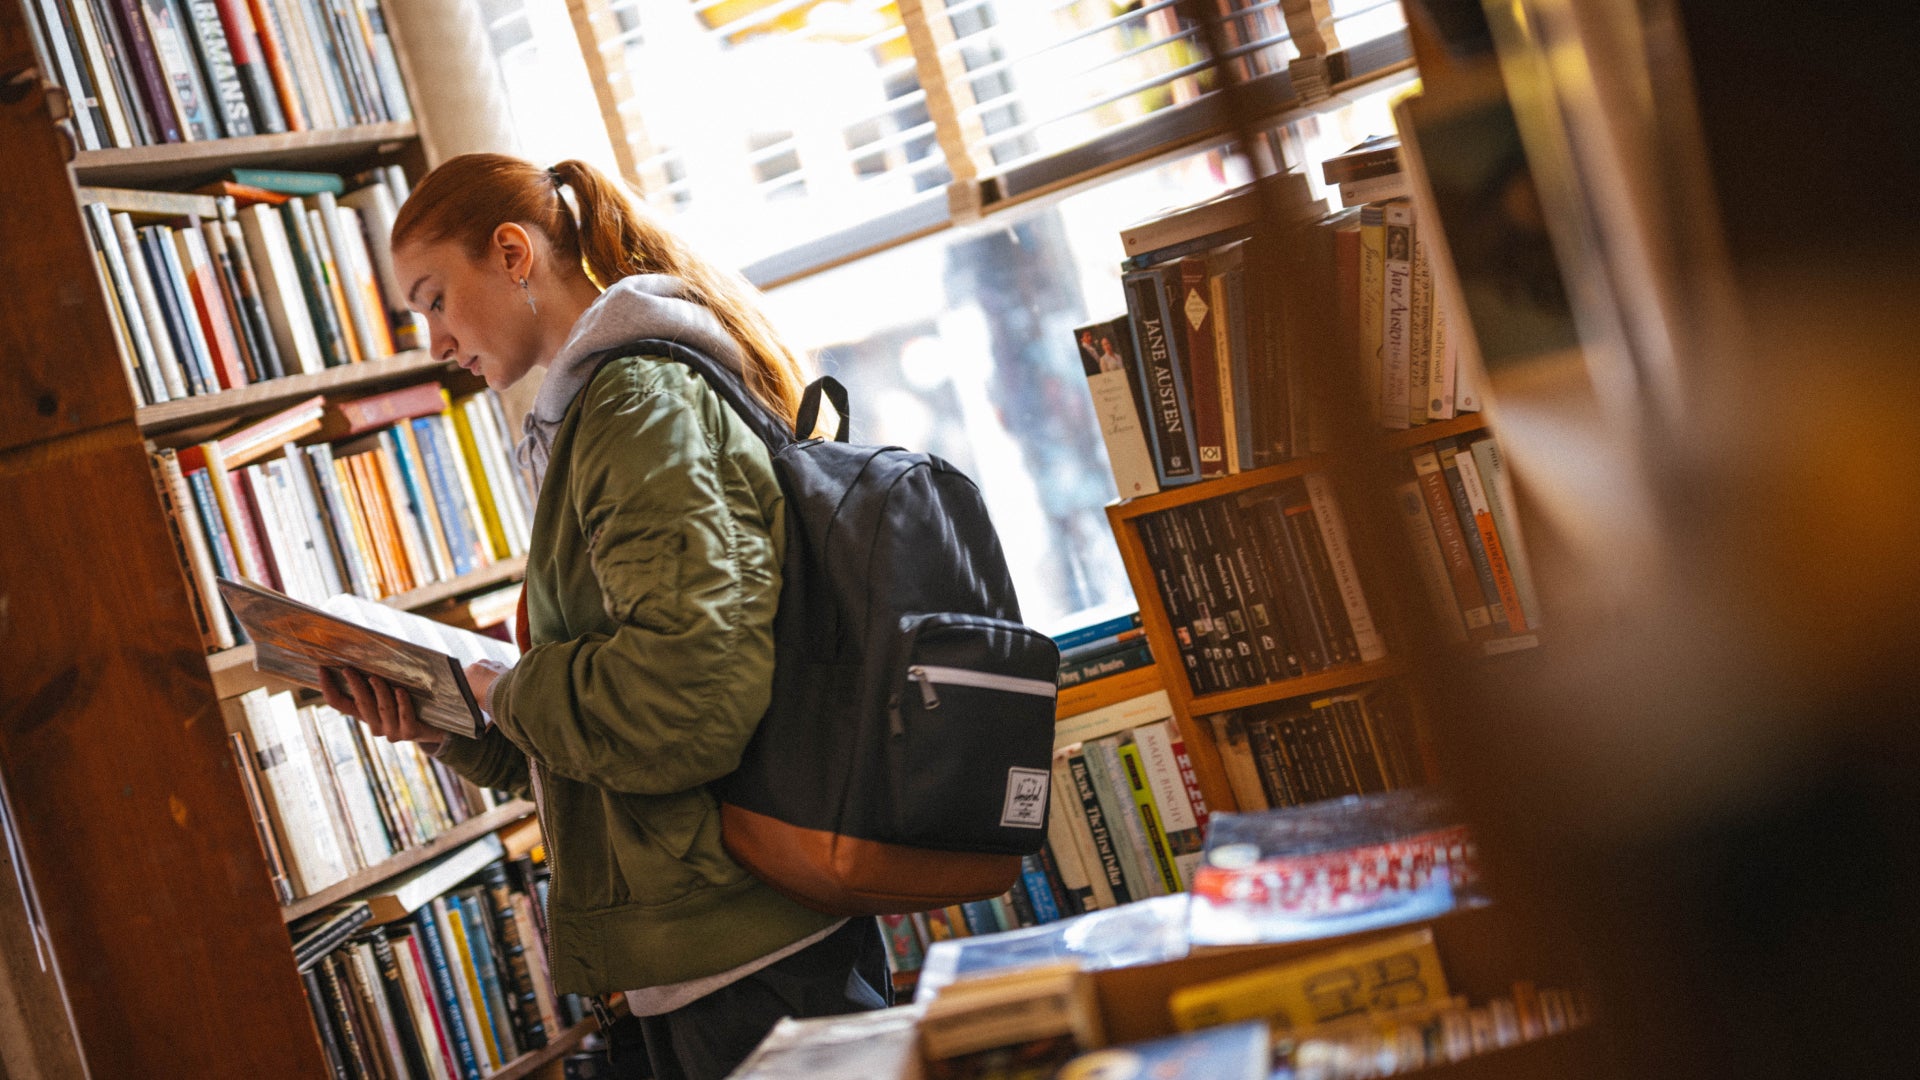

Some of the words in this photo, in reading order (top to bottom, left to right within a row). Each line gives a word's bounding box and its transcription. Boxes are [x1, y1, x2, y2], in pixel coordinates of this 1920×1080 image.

[1388, 265, 1410, 300] Jane
[1142, 317, 1168, 362] JANE
[1390, 297, 1409, 347] Austen
[1434, 359, 1444, 384] world
[1154, 364, 1183, 435] AUSTEN
[1425, 474, 1456, 540] MANSFIELD
[1447, 538, 1465, 568] PARK
[1212, 552, 1231, 586] Mansfield
[1222, 583, 1235, 601] Park
[1234, 546, 1252, 580] Mansfield
[1244, 578, 1257, 595] Park
[1336, 559, 1351, 585] BOOK
[1145, 734, 1169, 775] MAEVE
[1159, 778, 1185, 826] BINCHY
[1085, 805, 1105, 828] The
[1092, 826, 1113, 856] First
[1101, 853, 1124, 888] Polka
